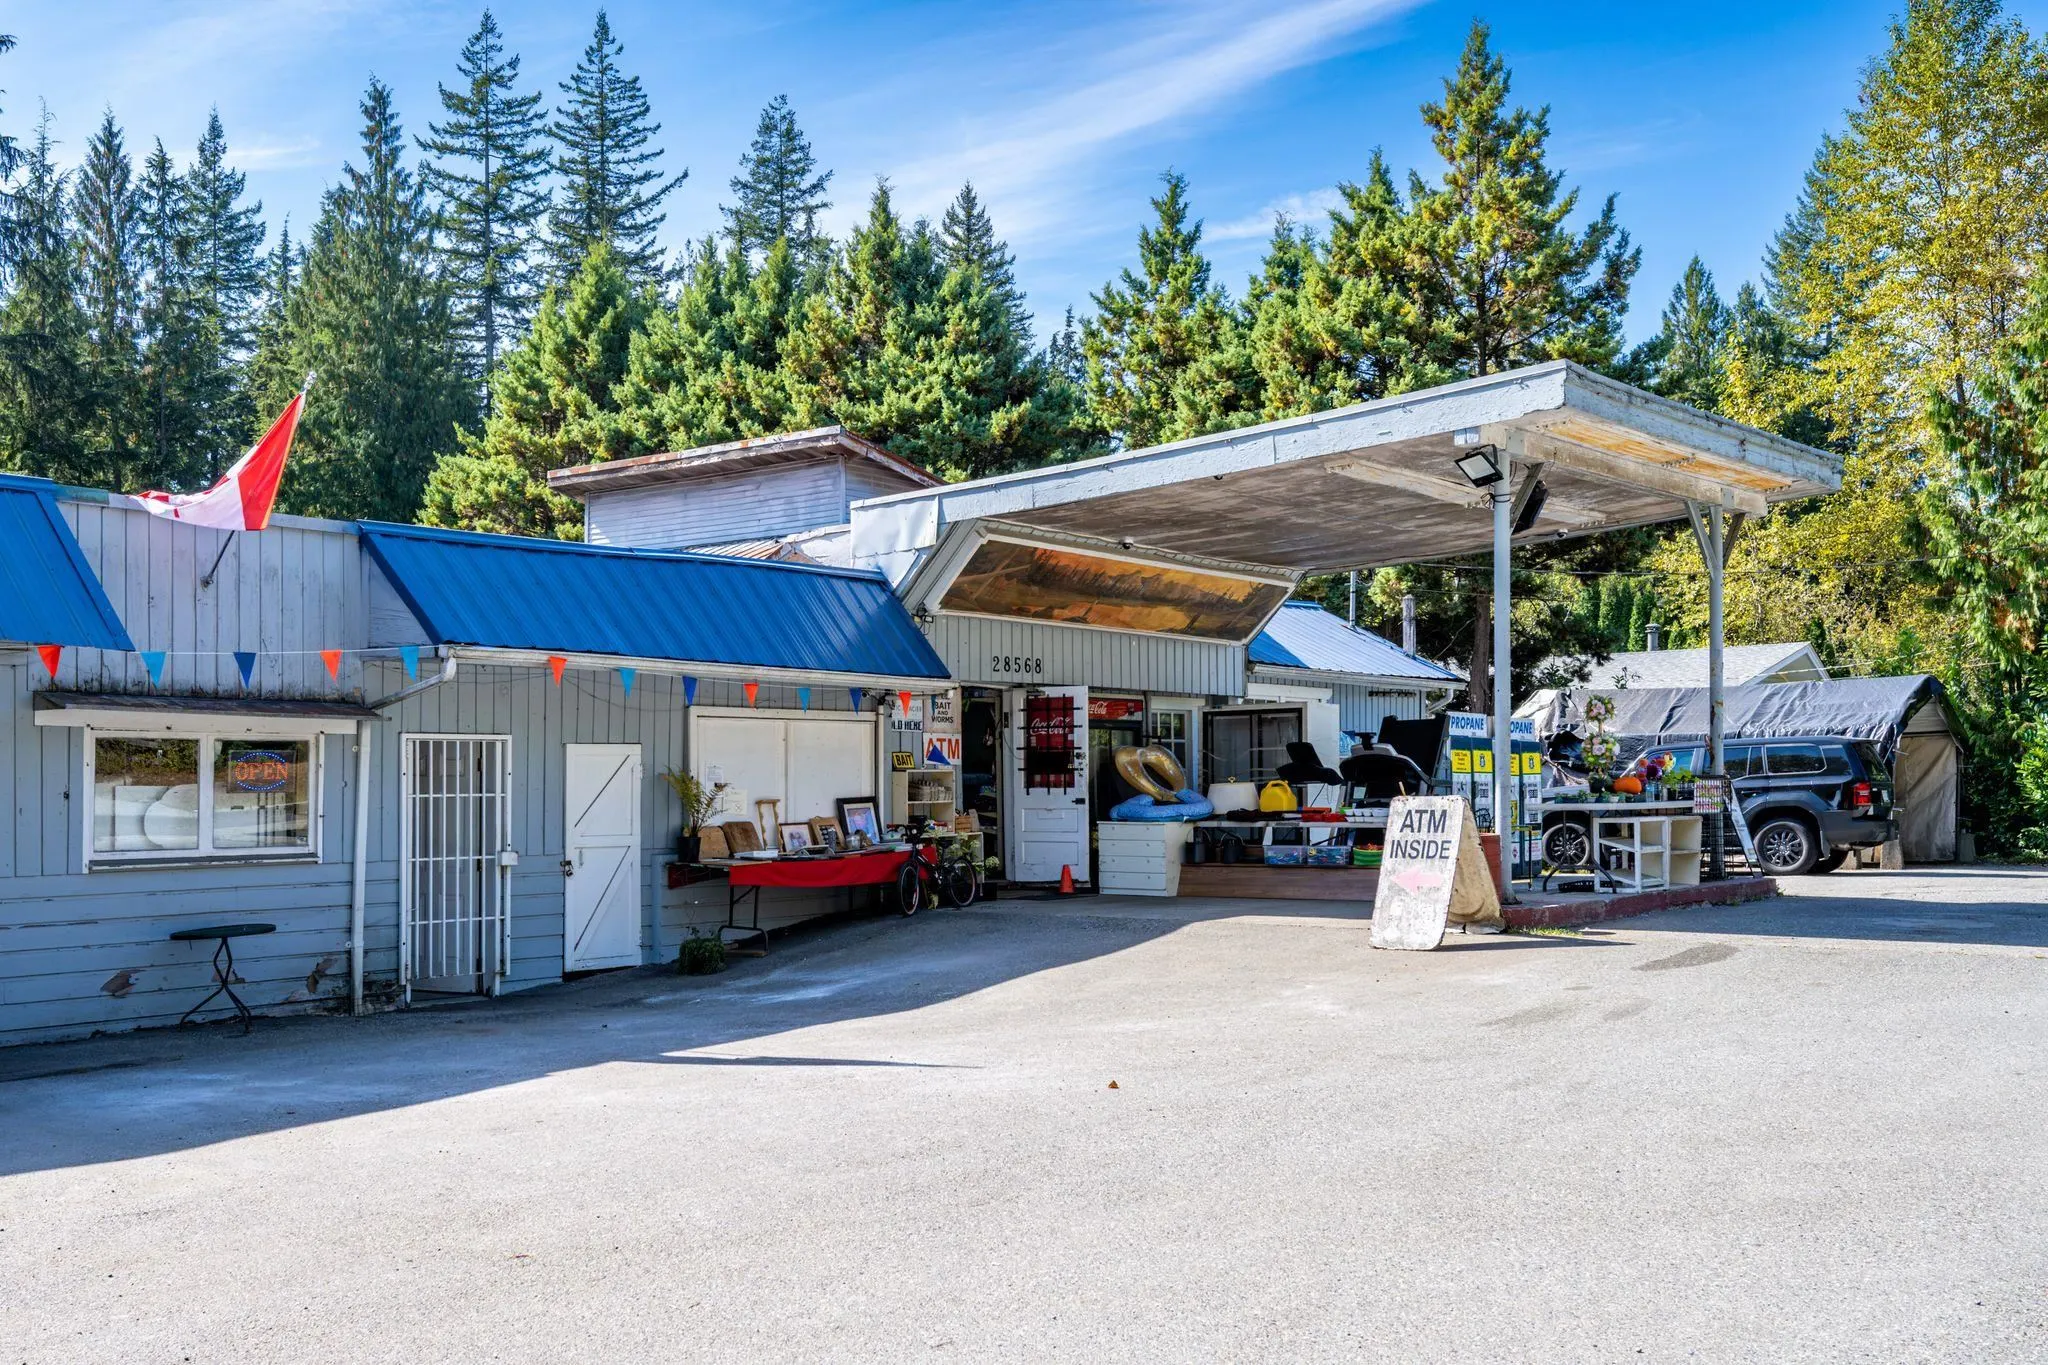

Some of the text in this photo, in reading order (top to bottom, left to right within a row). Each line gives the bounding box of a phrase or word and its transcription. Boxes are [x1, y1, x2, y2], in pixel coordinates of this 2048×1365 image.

[993, 656, 1041, 673] 28568
[934, 701, 951, 710] BAIT
[931, 716, 954, 724] WORMS
[1451, 716, 1484, 730] PROPANE
[1510, 721, 1532, 734] OPANE
[925, 738, 960, 760] ATM
[895, 754, 913, 767] BAIT
[235, 762, 289, 781] OPEN
[1400, 809, 1448, 834] ATM
[1389, 839, 1452, 860] INSIDE
